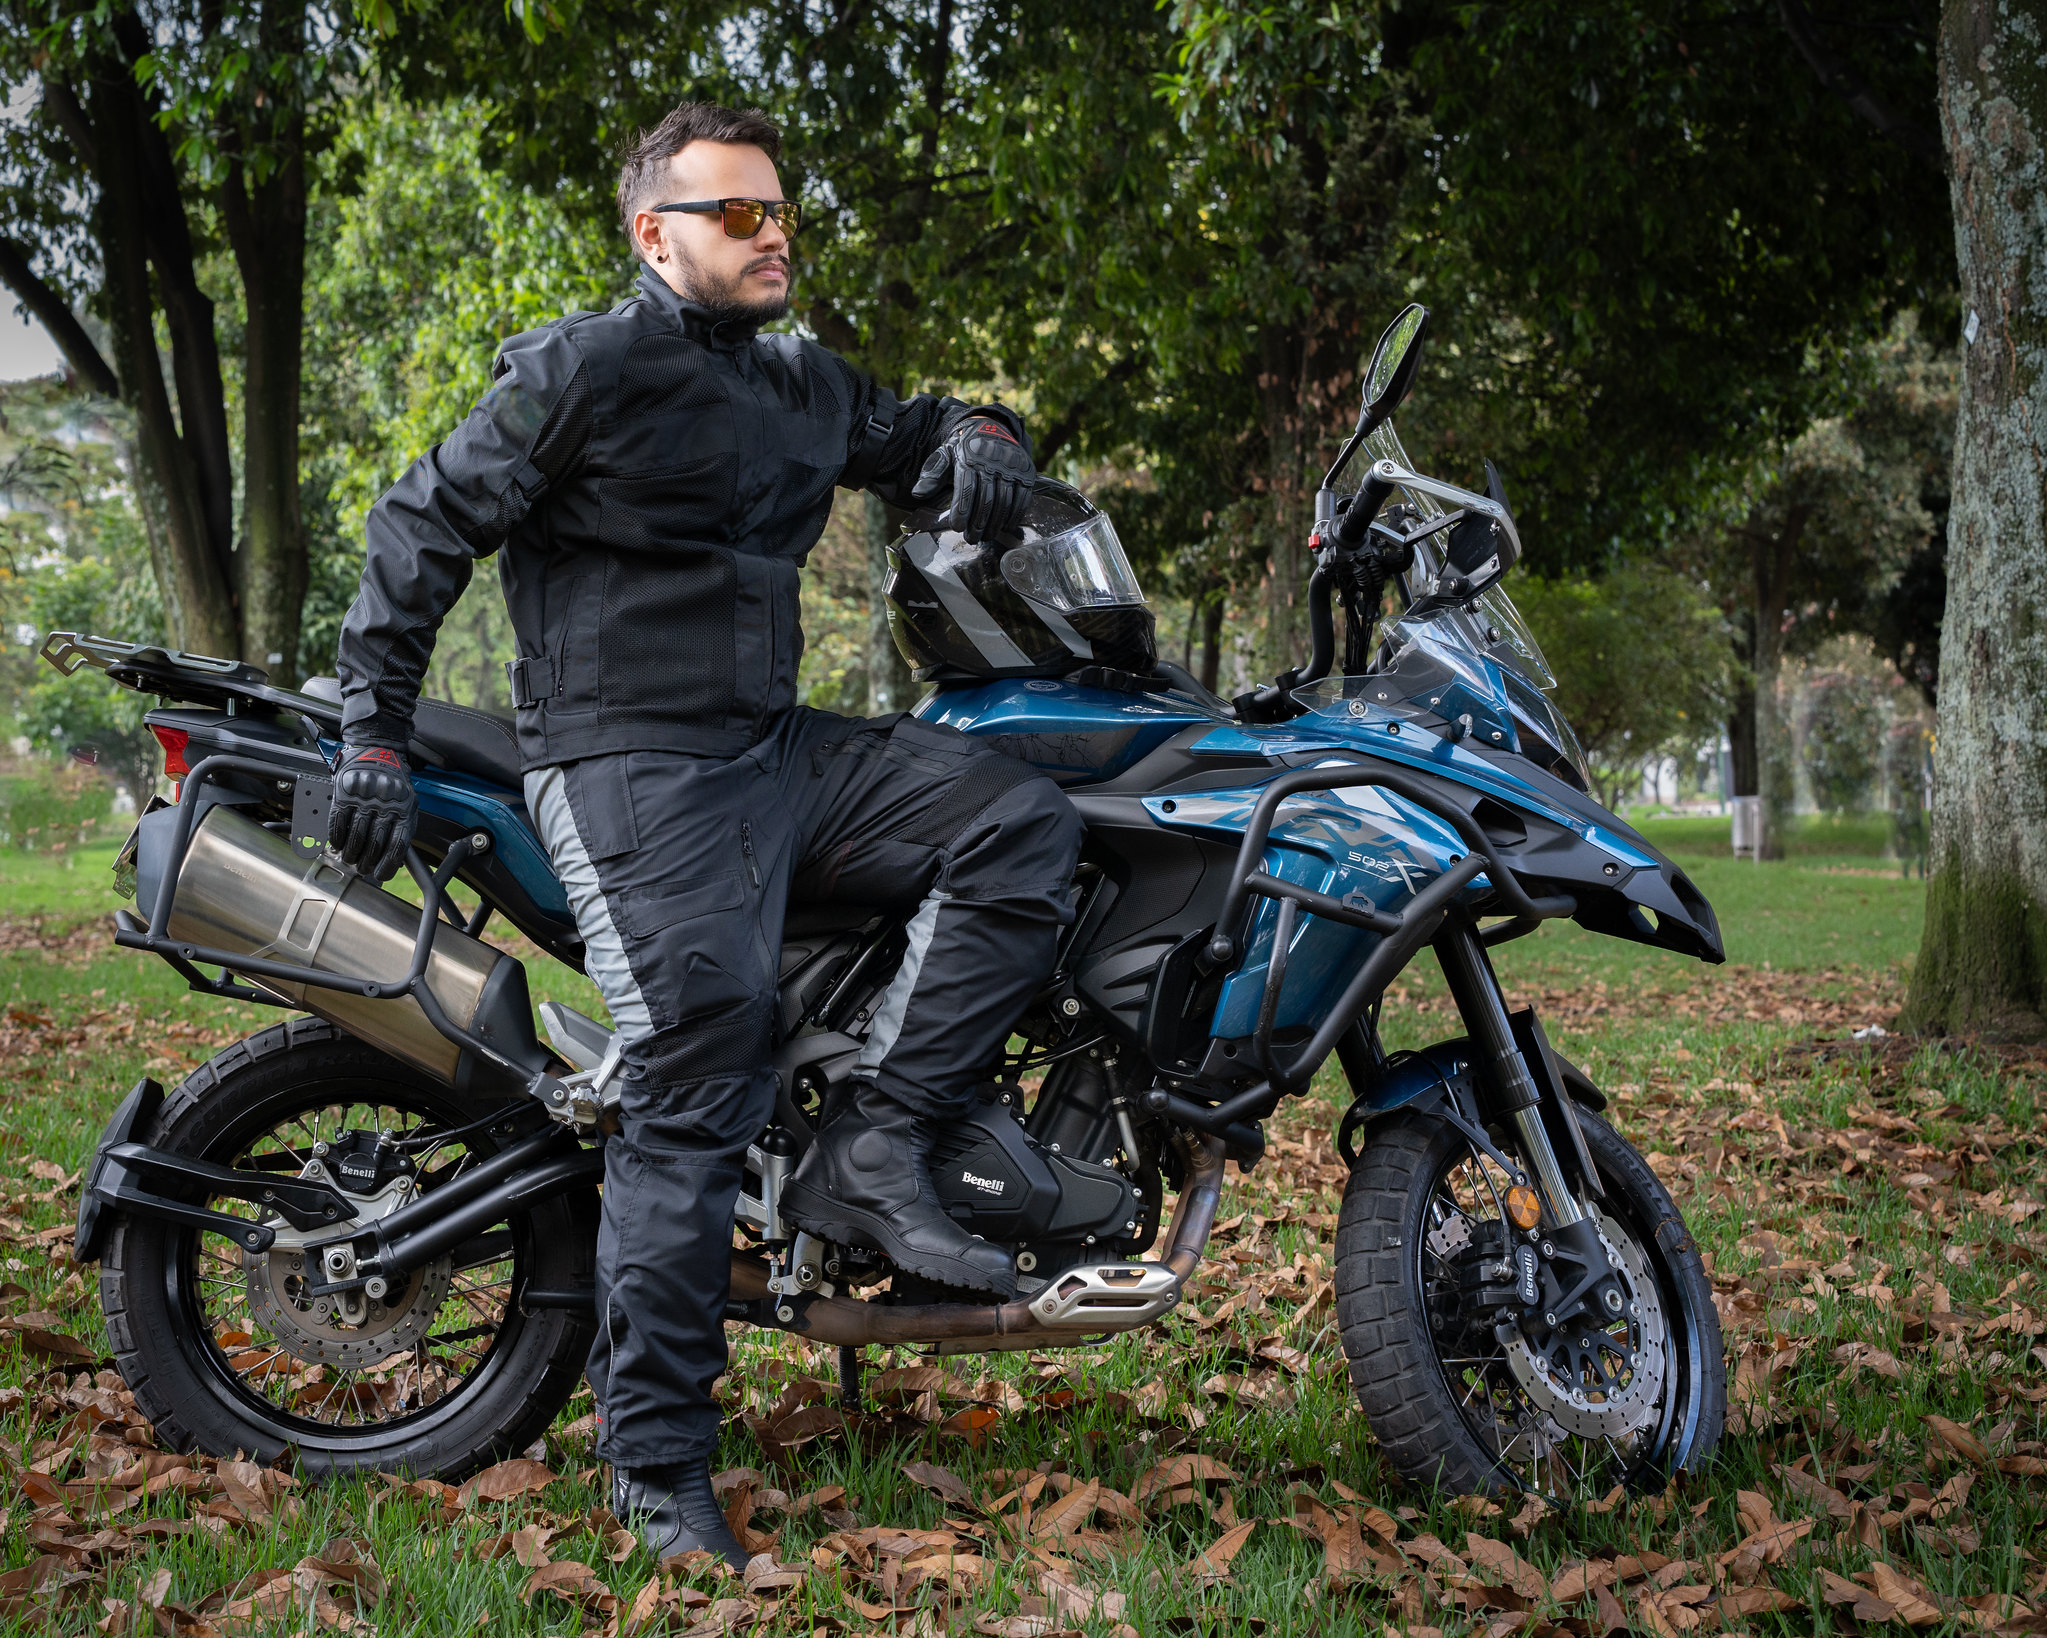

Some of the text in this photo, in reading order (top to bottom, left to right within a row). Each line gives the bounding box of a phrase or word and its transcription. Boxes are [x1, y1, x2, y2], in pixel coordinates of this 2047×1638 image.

[223, 863, 258, 884] Benelli
[341, 1165, 376, 1179] Benelli
[961, 1171, 1005, 1192] Benelli
[1599, 1135, 1673, 1218] PIRELLI
[1524, 1252, 1534, 1298] Benelli
